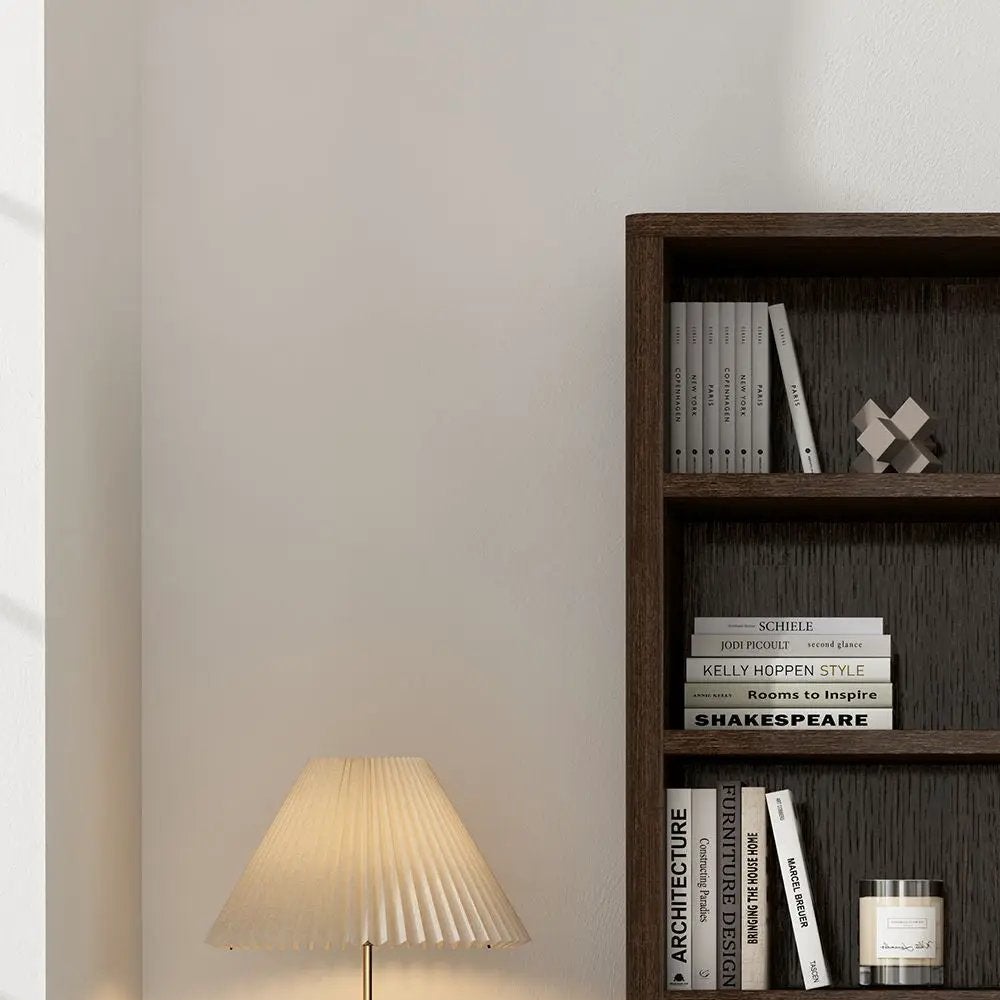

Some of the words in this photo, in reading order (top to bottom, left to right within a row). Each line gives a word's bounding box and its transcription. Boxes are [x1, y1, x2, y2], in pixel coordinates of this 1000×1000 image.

[791, 384, 800, 407] PARIS
[758, 621, 814, 632] SCHIELE
[721, 640, 744, 651] JODI
[746, 640, 790, 650] PICOULT
[807, 641, 835, 649] second
[837, 640, 863, 650] glance
[703, 664, 750, 677] KELLY
[754, 664, 815, 677] HOPPEN
[820, 664, 865, 677] STYLE
[748, 690, 800, 700] Rooms
[804, 691, 820, 700] to
[825, 690, 878, 702] Inspire
[694, 714, 869, 727] SHAKESPEARE
[722, 785, 736, 905] FURNITURE
[747, 832, 758, 856] HOME
[697, 837, 710, 888] Constructing
[747, 857, 758, 886] HOUSE
[671, 808, 687, 964] ARCHITECTURE
[747, 886, 758, 903] THE
[787, 857, 800, 892] MARCEL
[794, 893, 809, 928] BREUER
[747, 905, 758, 945] BRINGING
[722, 911, 736, 988] DESIGN
